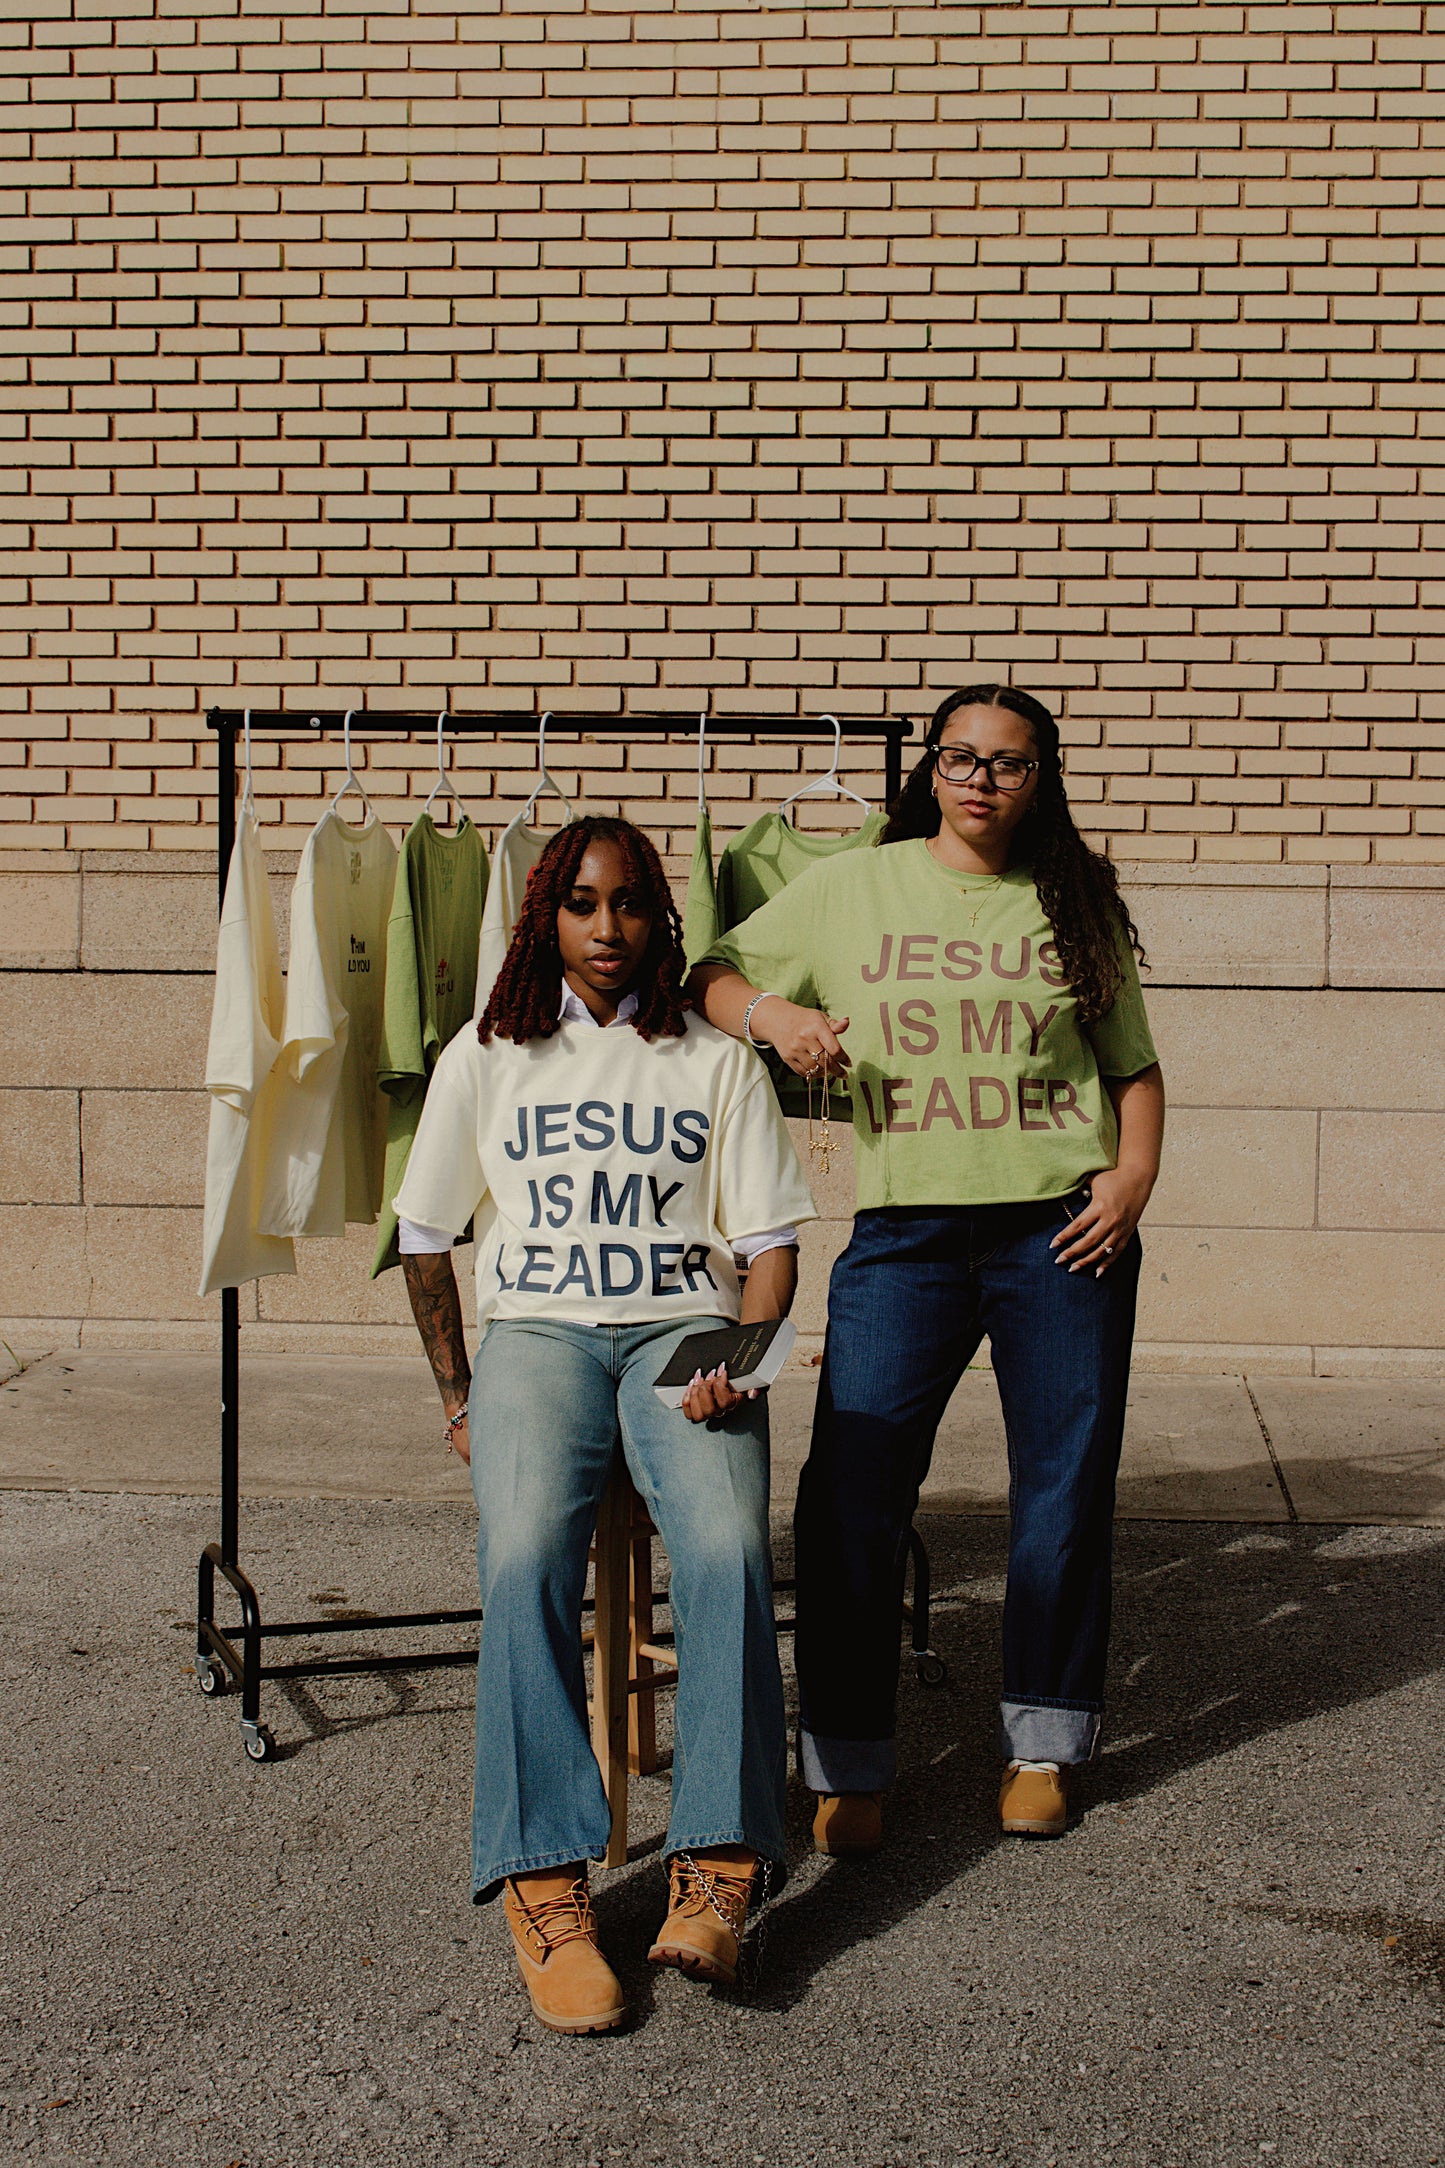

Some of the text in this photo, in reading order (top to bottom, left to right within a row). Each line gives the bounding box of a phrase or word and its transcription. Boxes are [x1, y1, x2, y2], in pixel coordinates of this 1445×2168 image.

[861, 934, 1069, 987] JESUS
[879, 999, 1059, 1056] IS MY
[504, 1101, 709, 1163] JESUS
[860, 1076, 1093, 1134] LEADER
[527, 1170, 684, 1229] IS MY
[496, 1243, 718, 1297] LEADER
